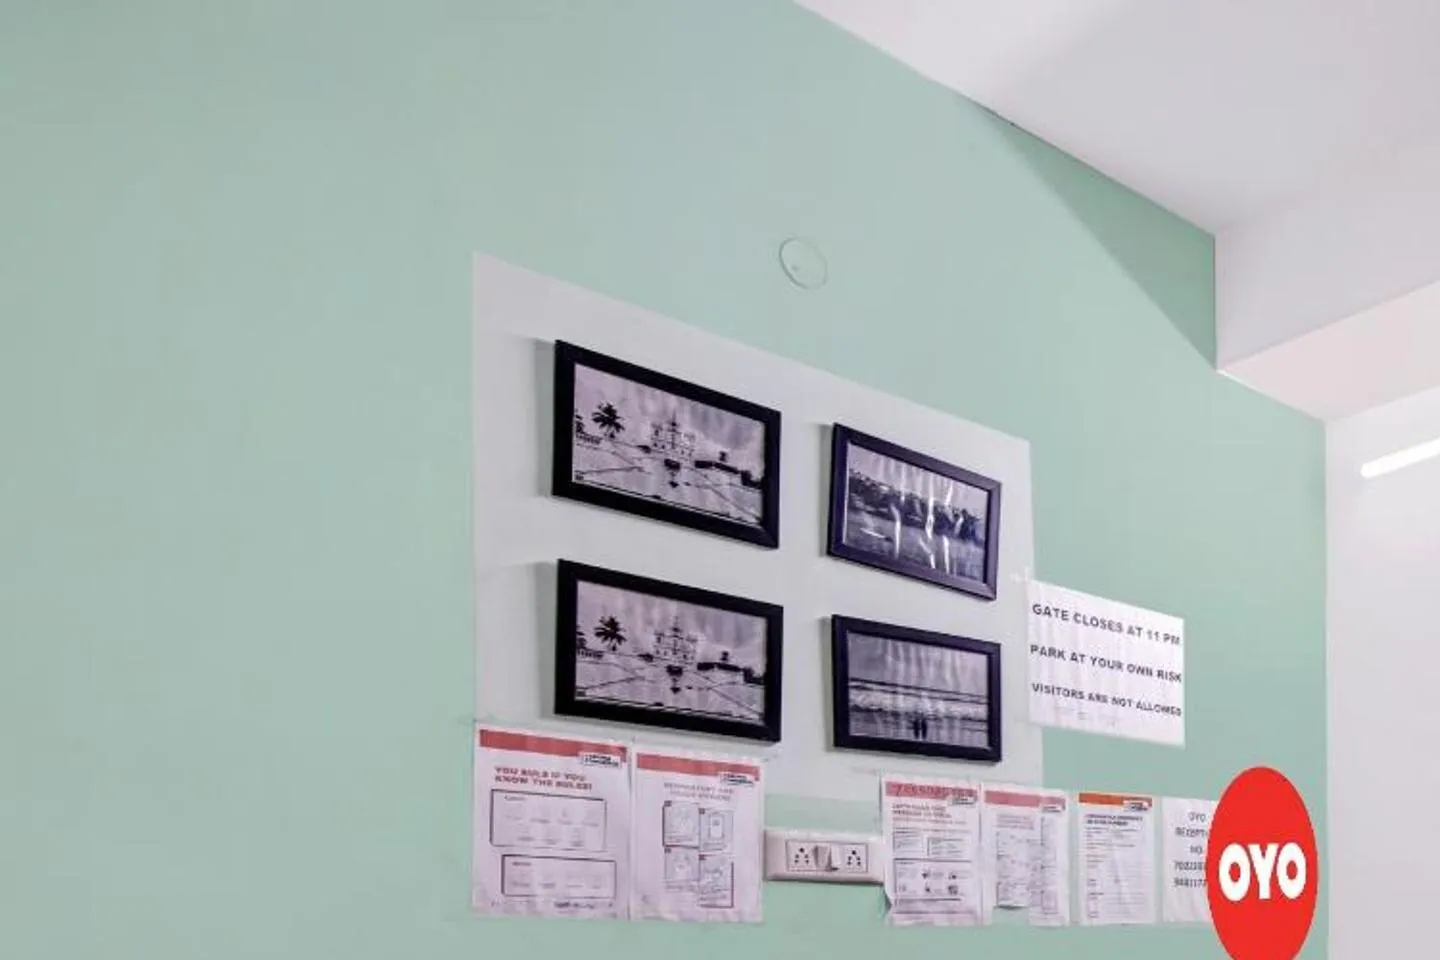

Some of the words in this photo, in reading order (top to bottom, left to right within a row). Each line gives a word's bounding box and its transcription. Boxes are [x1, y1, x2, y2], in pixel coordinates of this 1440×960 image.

[1032, 603, 1069, 621] GATE
[1073, 612, 1123, 633] CLOSES
[1127, 626, 1143, 637] AT
[1147, 630, 1160, 642] 11
[1163, 633, 1181, 645] PM
[1030, 644, 1066, 661] PARK
[1070, 652, 1086, 663] AT
[1090, 656, 1123, 671] YOUR
[1126, 664, 1153, 677] OWN
[1156, 669, 1182, 682] RISK
[1032, 683, 1085, 700] VISITORS
[1088, 693, 1109, 703] ARE
[1111, 696, 1133, 707] NOT
[1136, 701, 1182, 716] ALLOWED
[1218, 842, 1307, 902] OYO
